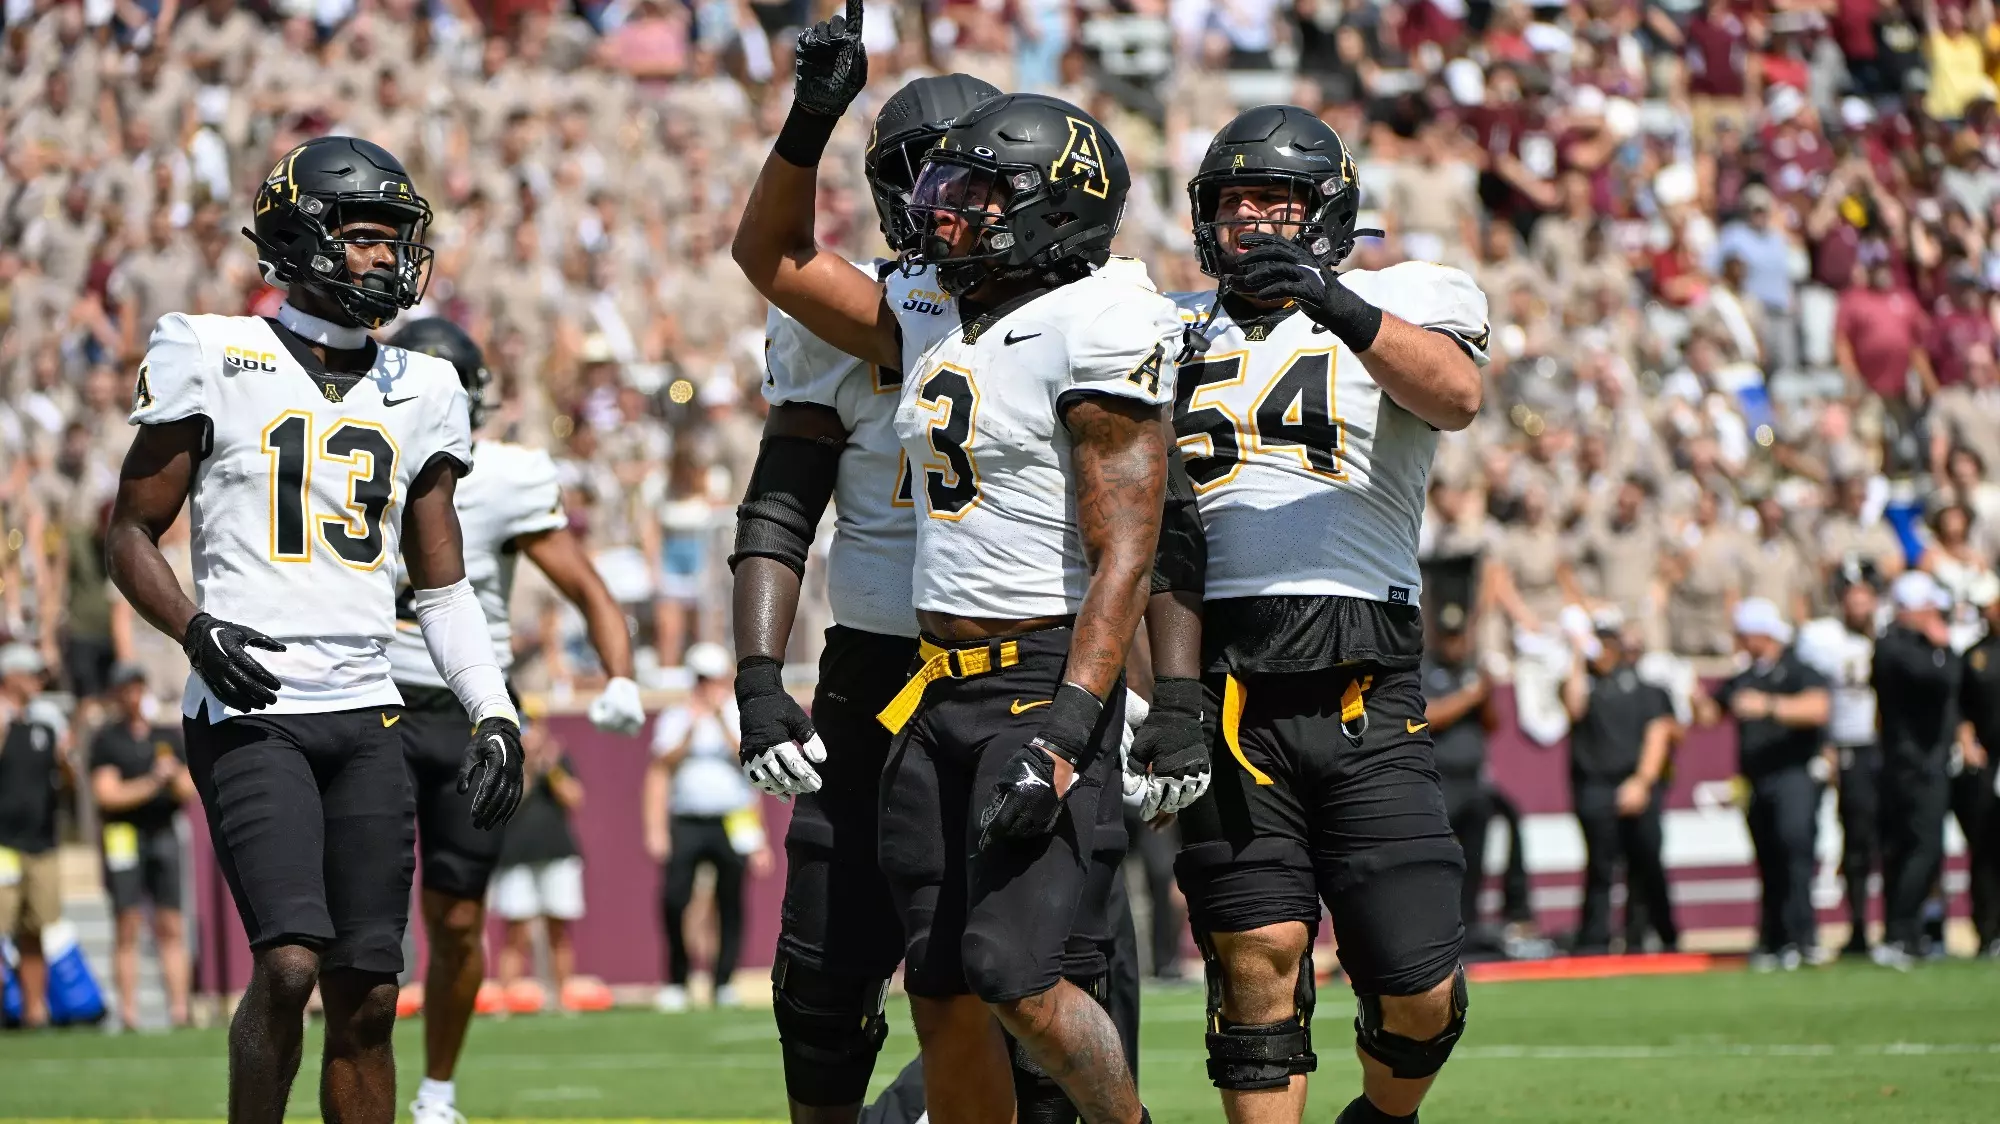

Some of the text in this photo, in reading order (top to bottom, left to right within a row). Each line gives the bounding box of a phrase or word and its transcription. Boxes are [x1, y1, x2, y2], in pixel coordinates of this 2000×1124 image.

[1050, 115, 1109, 200] A
[903, 288, 951, 316] SBC
[224, 345, 276, 373] SBC
[1127, 342, 1165, 398] A
[916, 360, 985, 522] 3
[1171, 345, 1350, 495] 54
[261, 408, 400, 571] 13
[1391, 590, 1406, 601] 2XL
